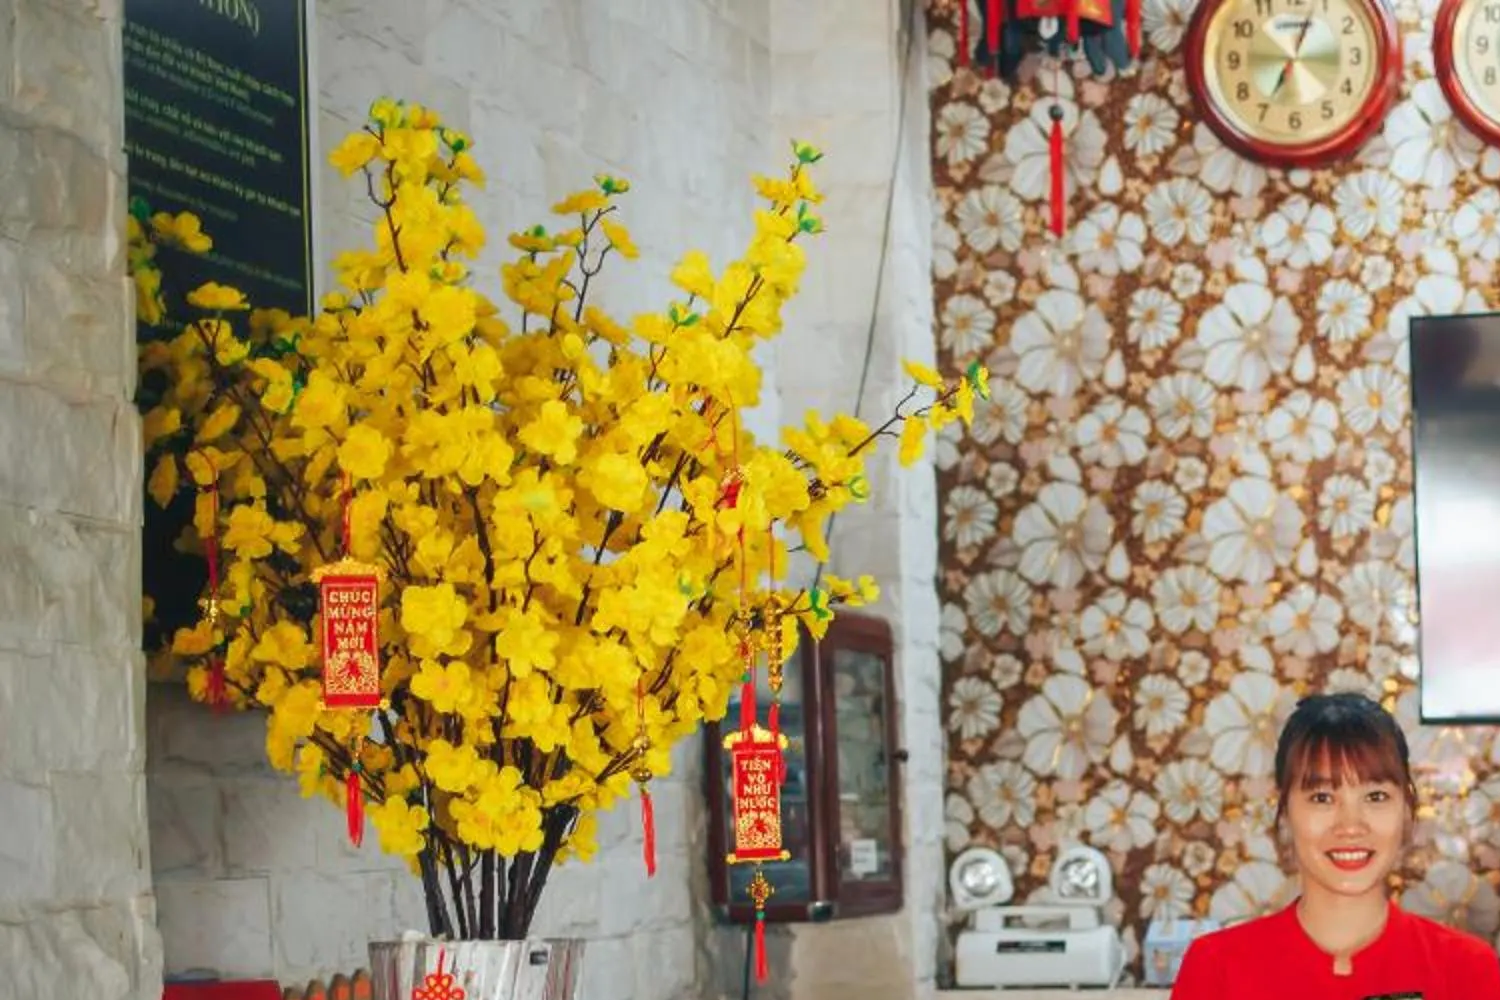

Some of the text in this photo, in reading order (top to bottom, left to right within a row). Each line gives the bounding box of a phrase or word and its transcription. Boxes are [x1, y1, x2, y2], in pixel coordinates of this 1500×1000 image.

[1233, 20, 1253, 38] 10
[1341, 16, 1355, 35] 2
[1475, 36, 1489, 56] 9
[1227, 51, 1241, 70] 9
[1349, 47, 1362, 66] 3
[1483, 66, 1497, 86] 8
[1236, 82, 1250, 101] 8
[1340, 77, 1353, 96] 4
[1257, 103, 1270, 122] 7
[1320, 101, 1334, 120] 5
[1288, 111, 1302, 130] 6
